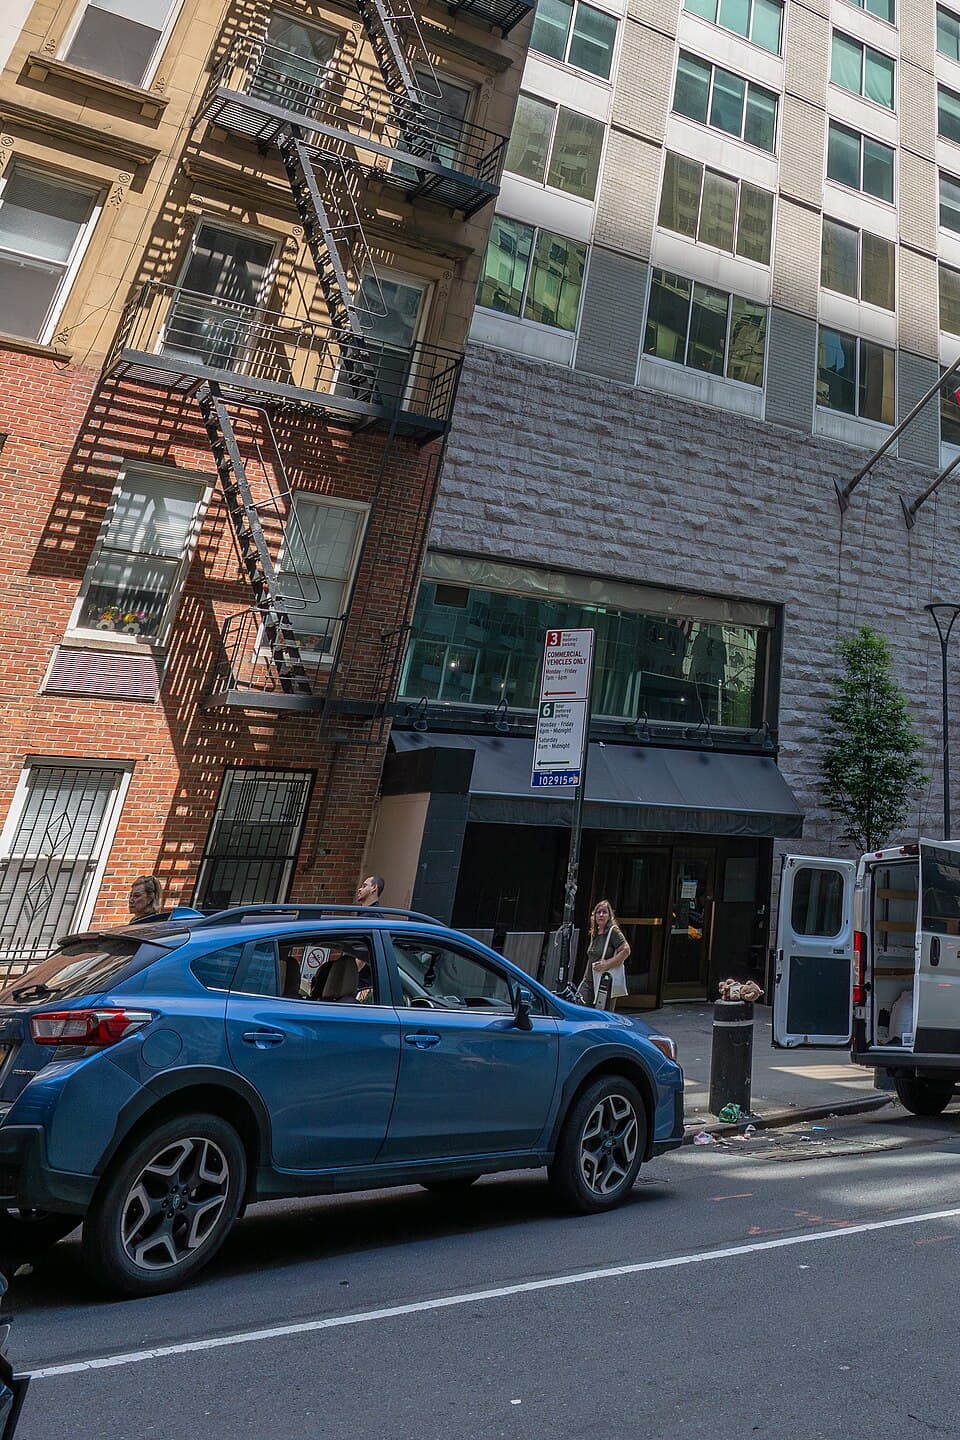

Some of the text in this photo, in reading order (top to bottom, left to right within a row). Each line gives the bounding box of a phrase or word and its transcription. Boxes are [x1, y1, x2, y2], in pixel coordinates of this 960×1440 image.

[550, 632, 558, 646] 3
[547, 650, 581, 658] COMMERCIAL
[573, 657, 587, 665] ONLY
[542, 703, 551, 717] 6
[539, 775, 568, 786] 102915
